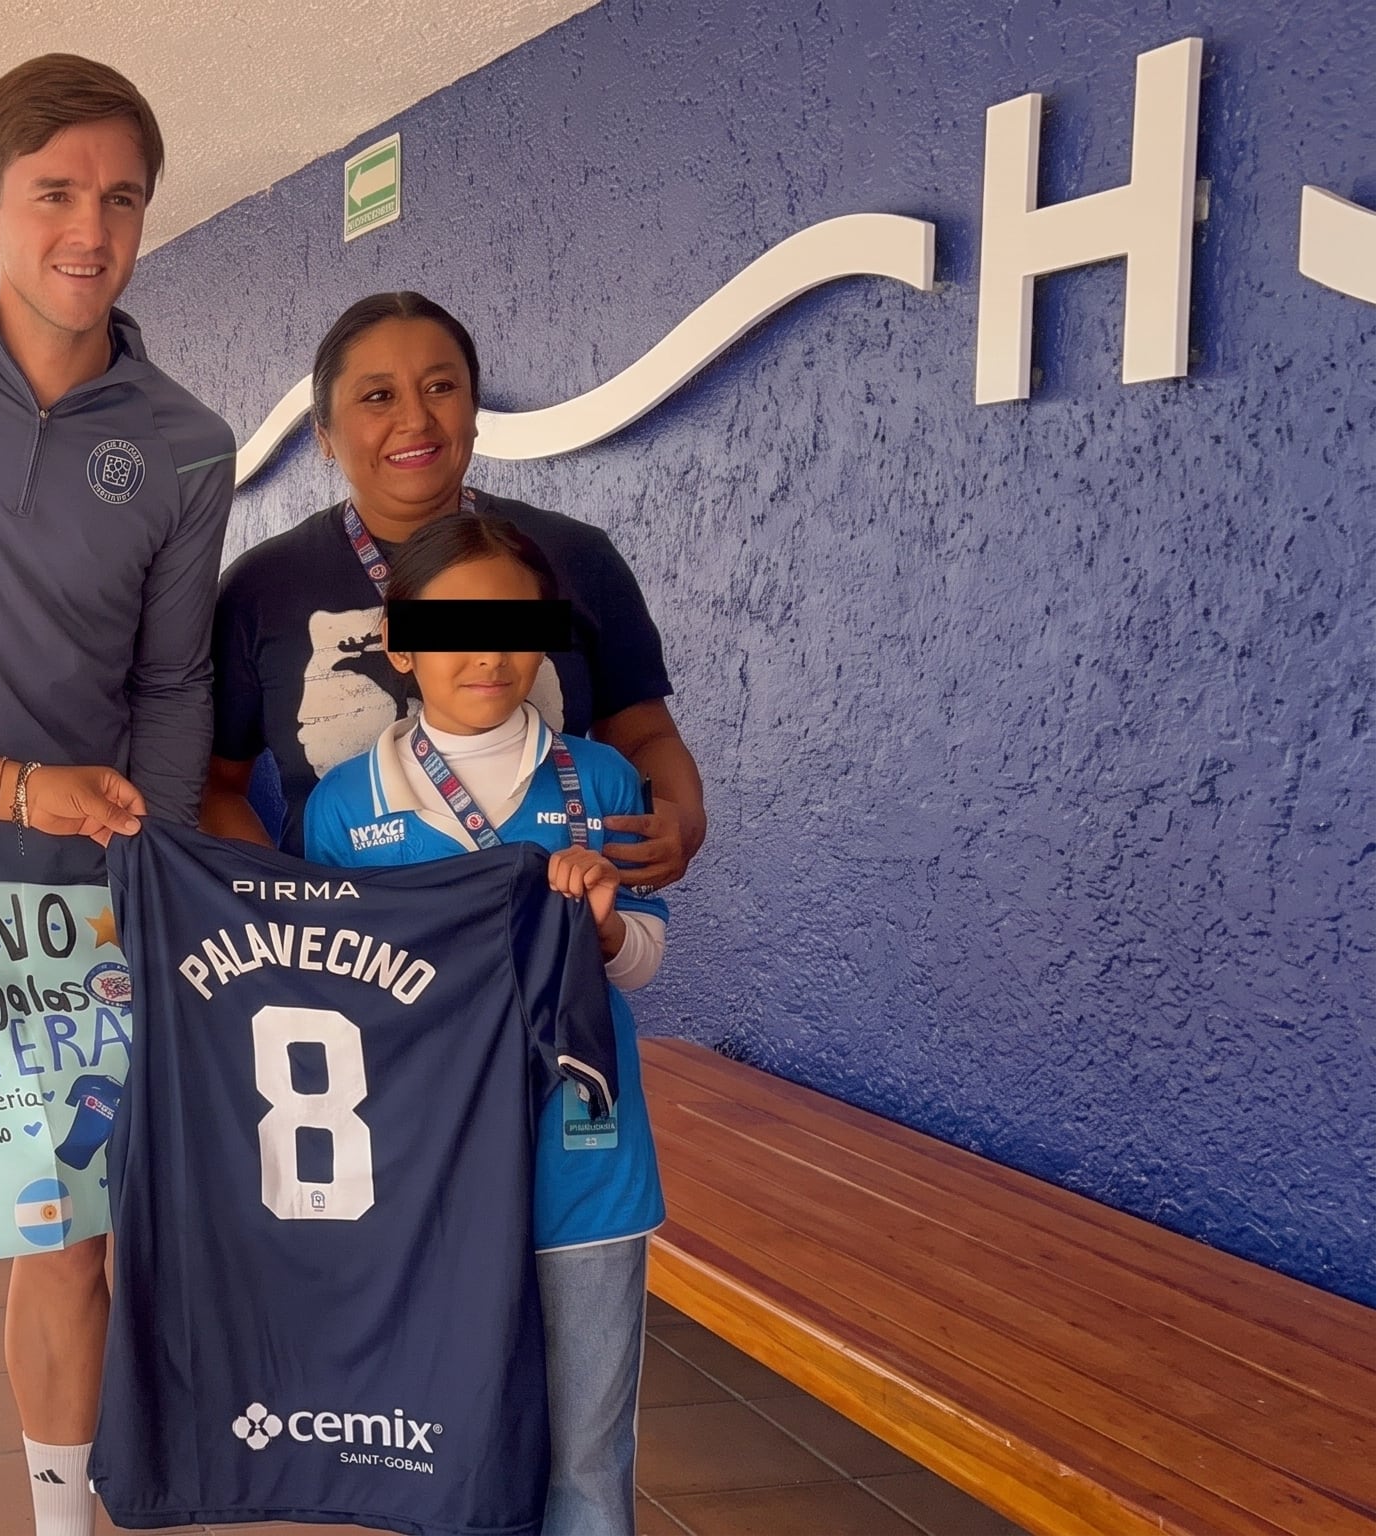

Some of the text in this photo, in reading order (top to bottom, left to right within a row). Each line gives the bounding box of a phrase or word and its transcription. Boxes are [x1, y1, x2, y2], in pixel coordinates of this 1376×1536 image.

[976, 37, 1203, 405] H
[232, 880, 361, 900] PIRMA
[178, 922, 437, 1005] PALAVECINO
[251, 1005, 376, 1222] 8
[340, 1452, 433, 1474] SAINT-GOBAIN
